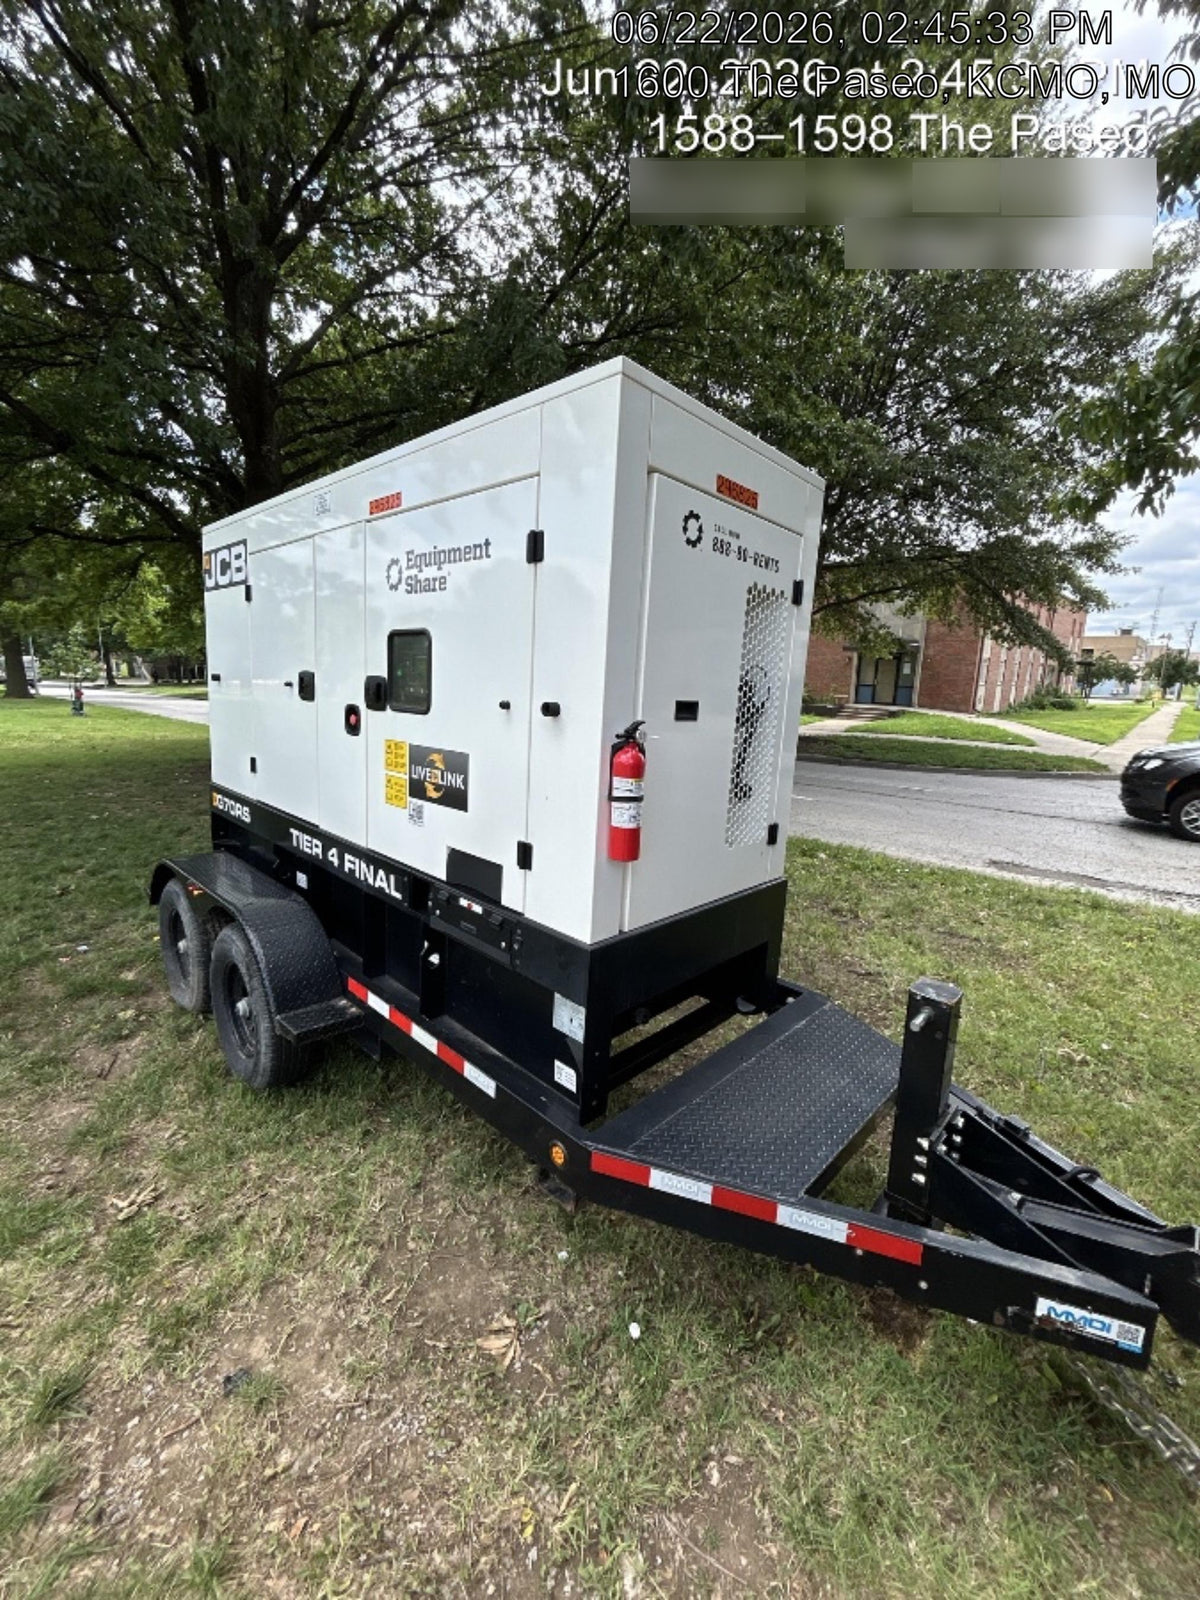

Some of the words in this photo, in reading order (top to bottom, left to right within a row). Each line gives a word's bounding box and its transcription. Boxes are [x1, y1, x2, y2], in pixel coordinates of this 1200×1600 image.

[205, 543, 246, 588] JCB
[405, 537, 492, 573] Equipment
[404, 573, 448, 595] Share
[289, 827, 323, 860] TIER
[327, 847, 339, 868] 4
[344, 853, 402, 900] FINAL
